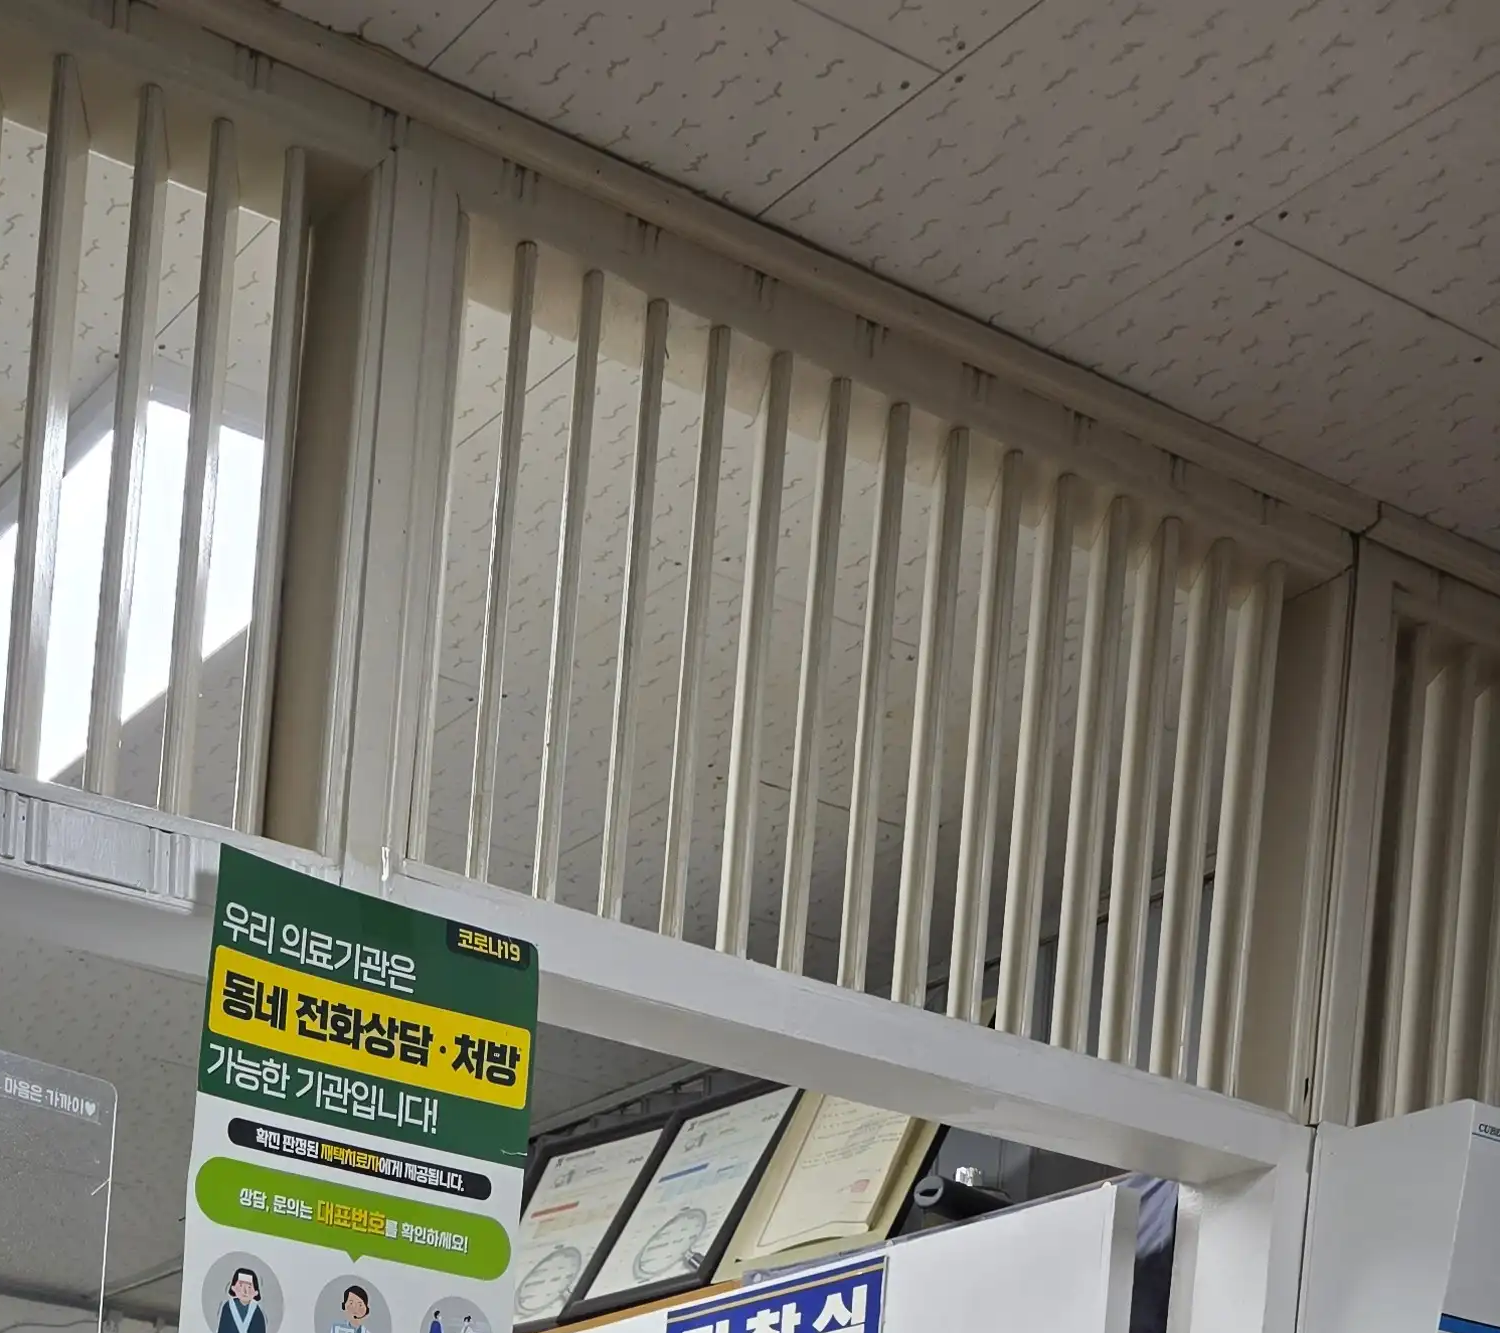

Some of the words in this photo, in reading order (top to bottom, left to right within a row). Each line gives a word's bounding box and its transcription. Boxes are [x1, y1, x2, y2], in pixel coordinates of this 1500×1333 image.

[223, 902, 275, 954] 우리
[280, 924, 416, 993] 의료기관은
[458, 928, 520, 962] 코로나19
[223, 970, 288, 1031] 동네
[4, 1077, 42, 1102] 마음은
[207, 1043, 290, 1099] 가능한
[296, 1067, 438, 1134] 기관입니다!
[256, 1128, 280, 1147] 확진
[282, 1136, 318, 1159] 판정된
[319, 1143, 402, 1179] 재택치료자에게
[404, 1163, 464, 1192] 제공됩니다.
[239, 1188, 270, 1212] 상담,
[273, 1197, 313, 1220] 문의는
[316, 1200, 398, 1239] 대표번호를
[401, 1223, 468, 1254] 확인하세요!
